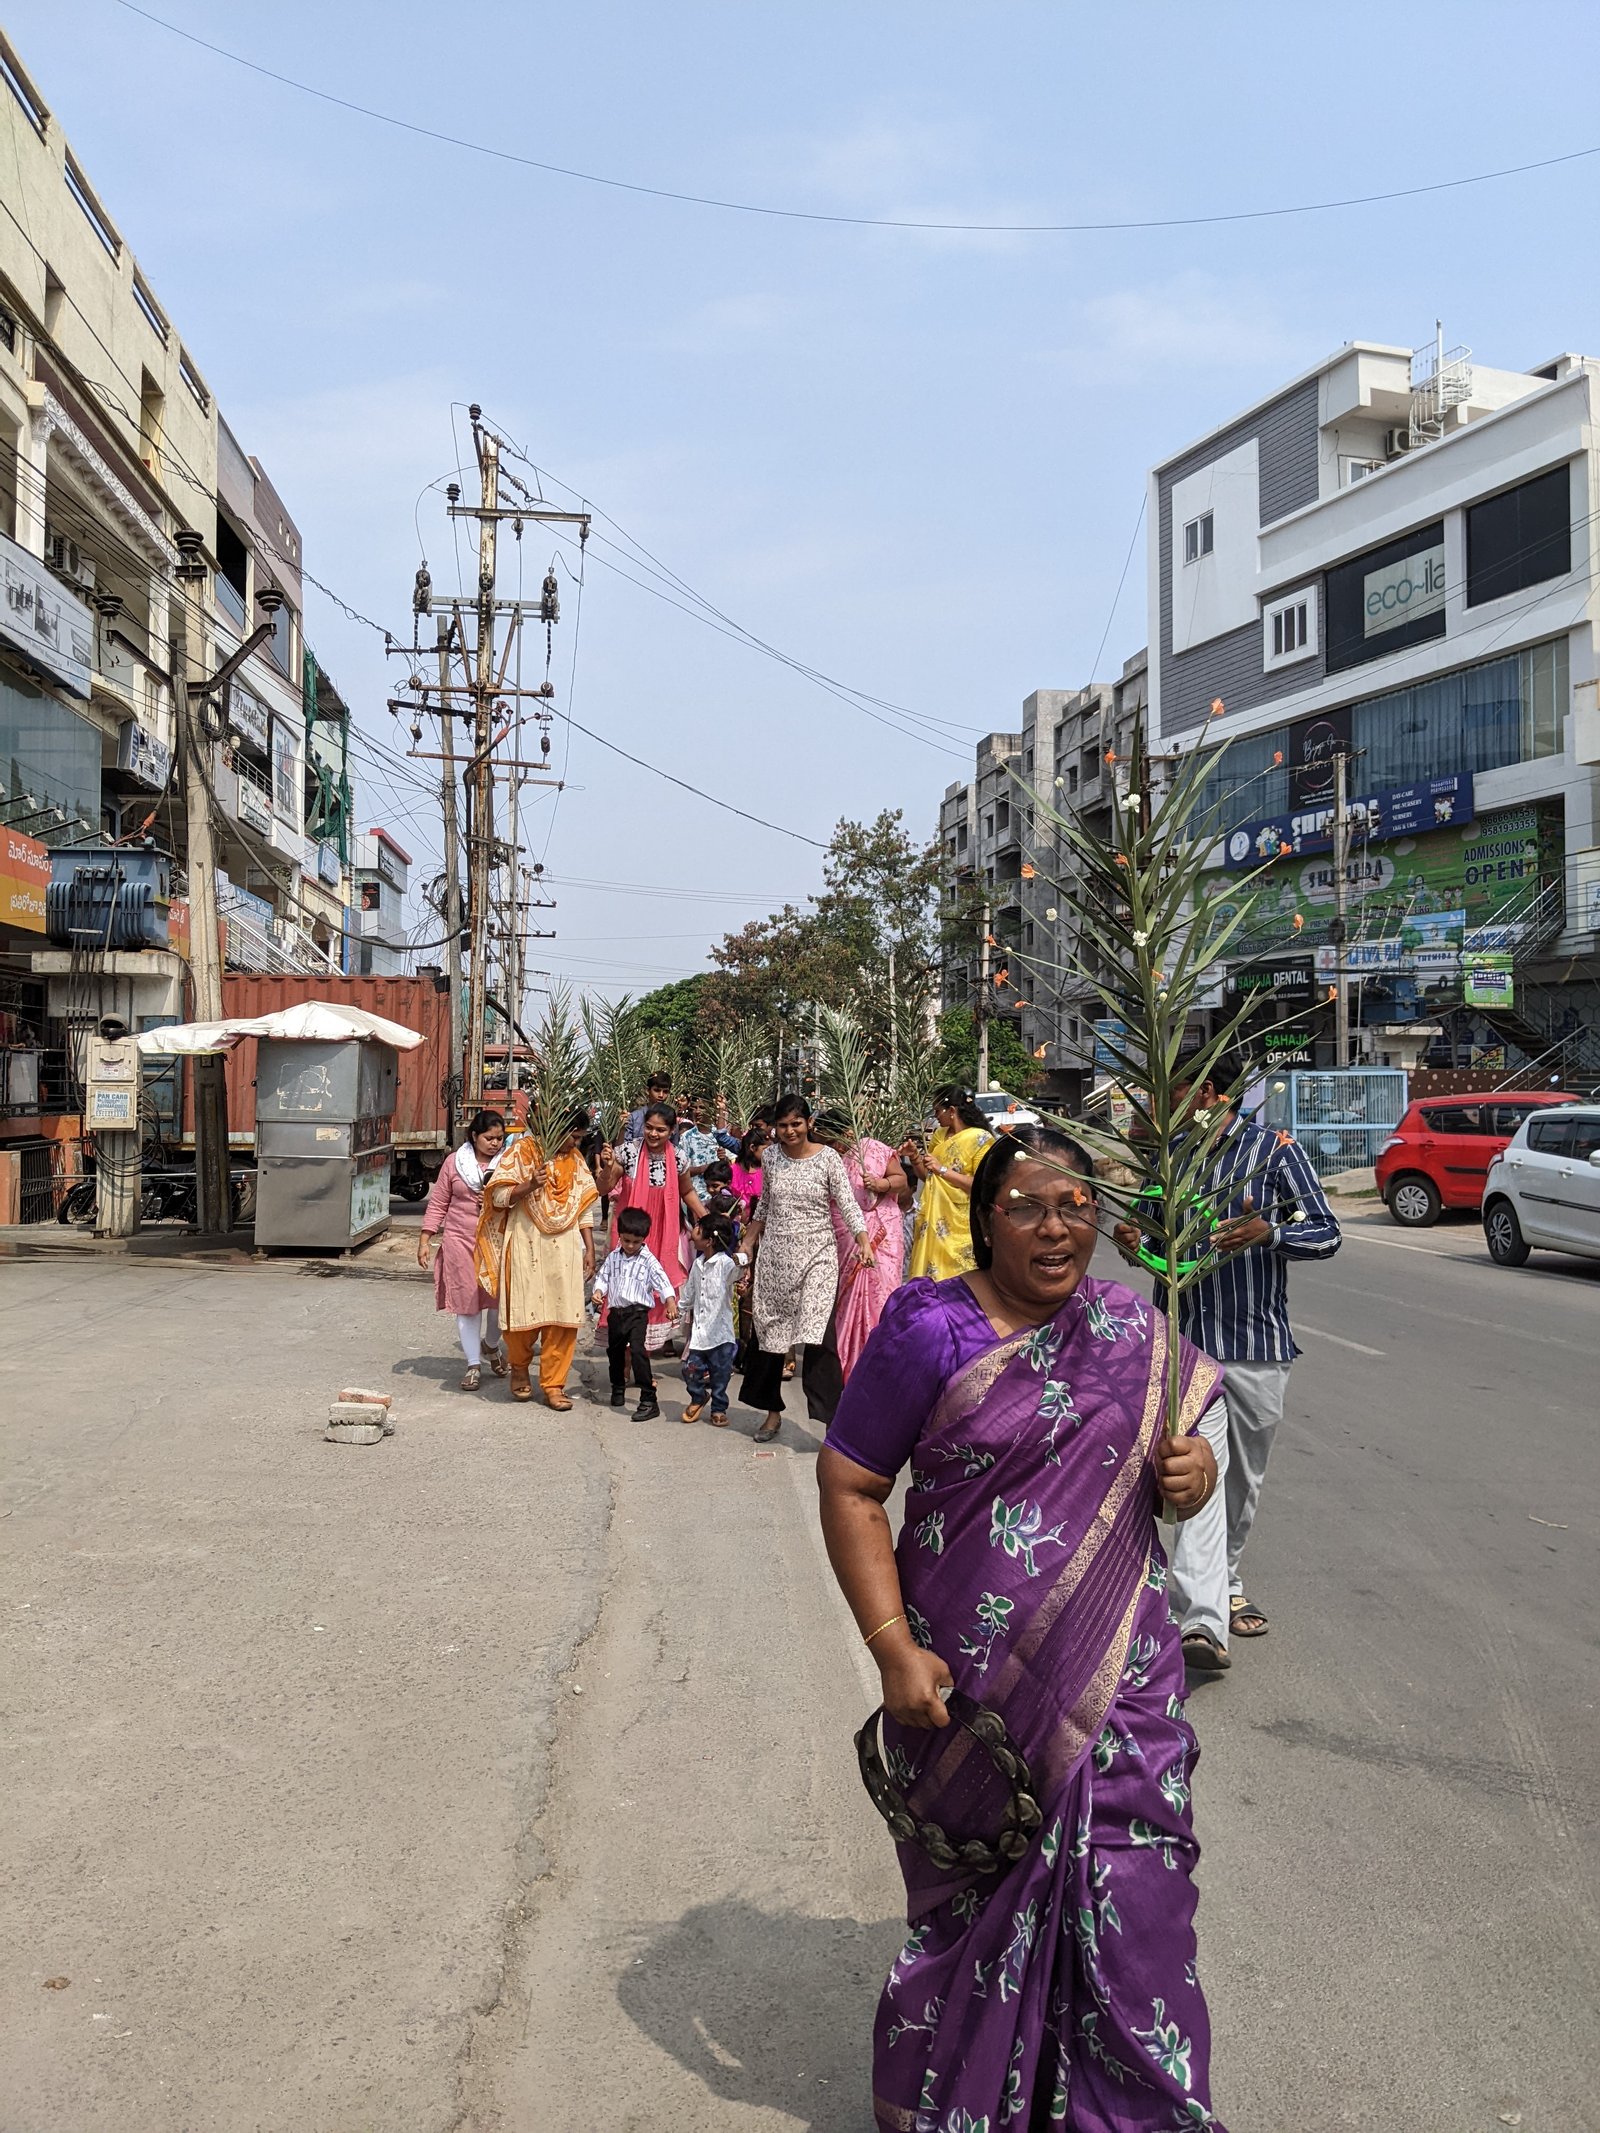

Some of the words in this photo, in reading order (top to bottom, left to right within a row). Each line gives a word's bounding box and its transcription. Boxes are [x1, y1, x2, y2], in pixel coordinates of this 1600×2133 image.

[1482, 818, 1536, 837] 9581933355
[1463, 839, 1525, 863] ADMISSIONS
[1465, 858, 1524, 886] OPEN
[1237, 974, 1272, 991] SAHAJA
[1273, 971, 1310, 987] DENTAL
[1265, 1034, 1310, 1047] SAHAJA
[1266, 1051, 1312, 1064] DENTAL
